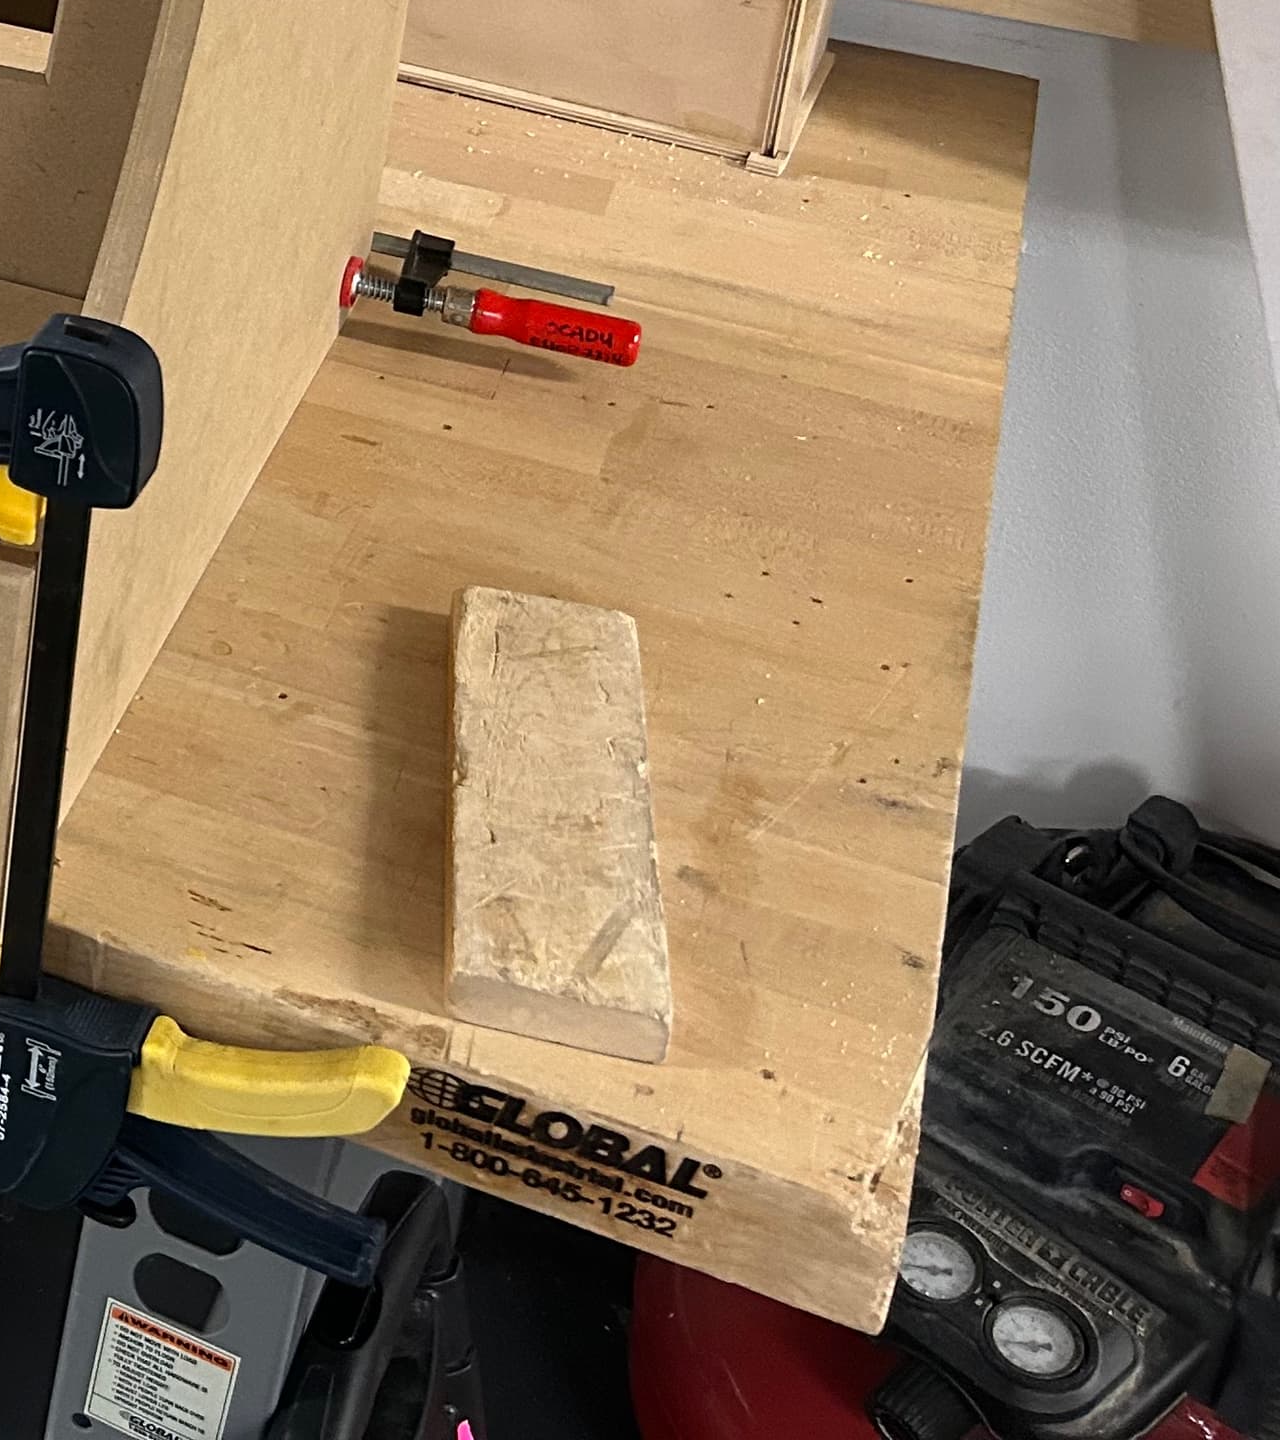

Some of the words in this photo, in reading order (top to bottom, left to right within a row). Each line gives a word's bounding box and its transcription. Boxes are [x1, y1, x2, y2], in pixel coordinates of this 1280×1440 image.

[1011, 975, 1102, 1032] 150
[1167, 1055, 1191, 1077] 6
[1115, 1099, 1135, 1114] PSI
[419, 1131, 678, 1238] 1-800-645-1232
[130, 1315, 228, 1368] WARNING
[129, 1415, 180, 1440] GLOBA
